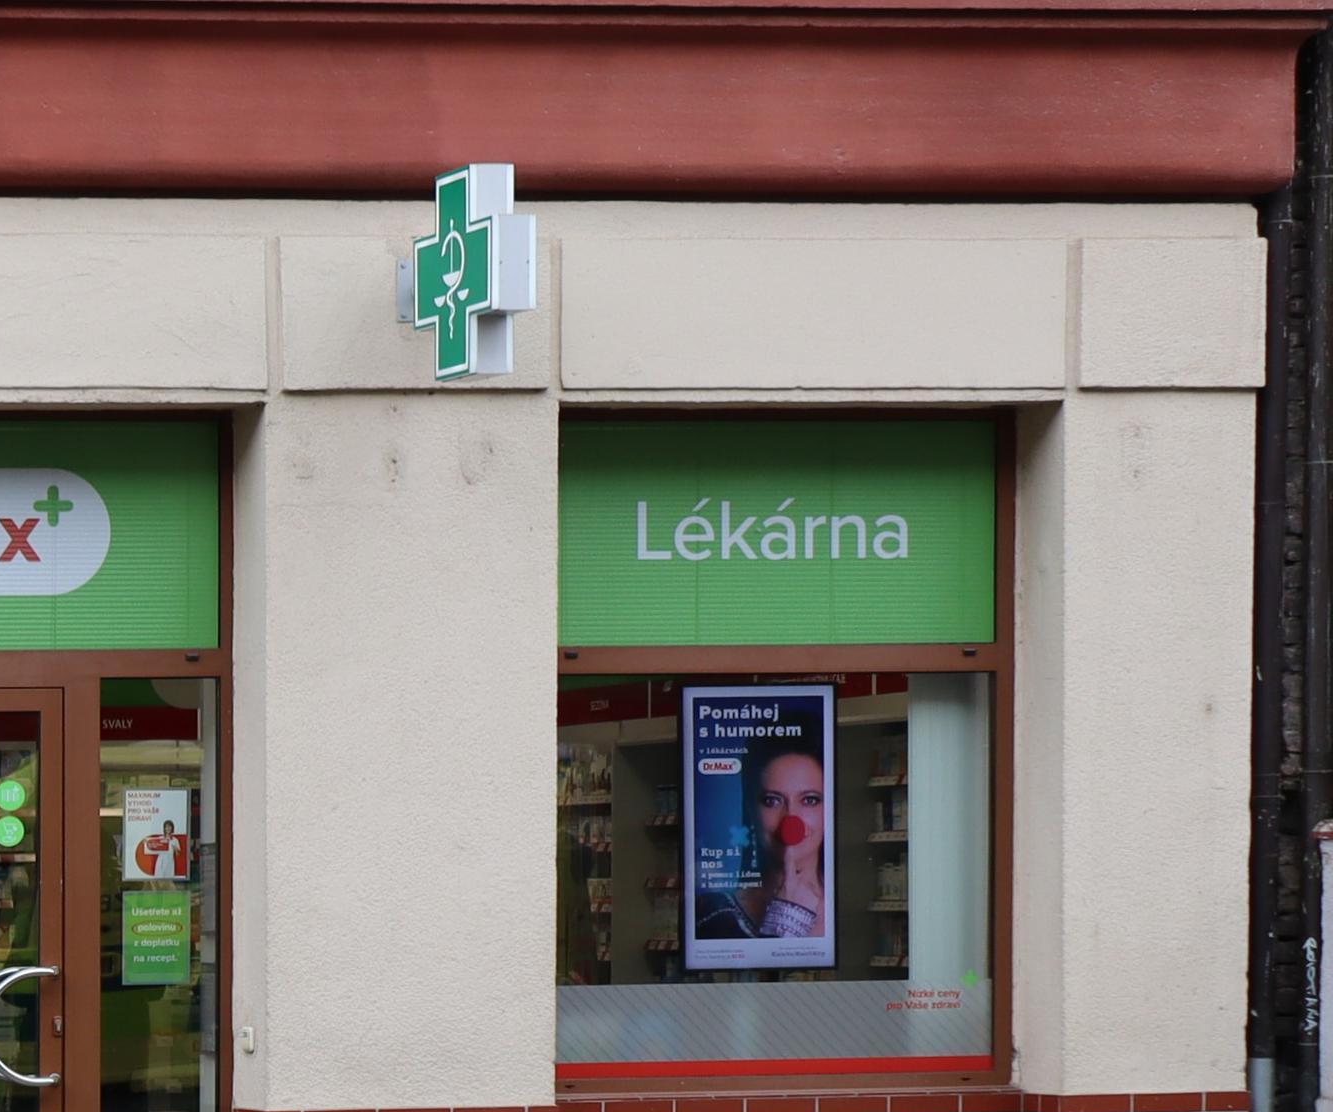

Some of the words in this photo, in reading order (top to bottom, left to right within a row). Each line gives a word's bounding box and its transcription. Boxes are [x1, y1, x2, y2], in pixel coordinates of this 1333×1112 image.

[634, 498, 910, 562] Lékárna
[699, 703, 779, 721] Pomáhej
[102, 719, 133, 729] SVALY
[699, 727, 709, 738] s
[714, 723, 802, 738] humorem
[701, 848, 724, 859] Kup
[726, 848, 742, 857] si
[701, 861, 724, 869] nos
[137, 922, 176, 933] polovinu
